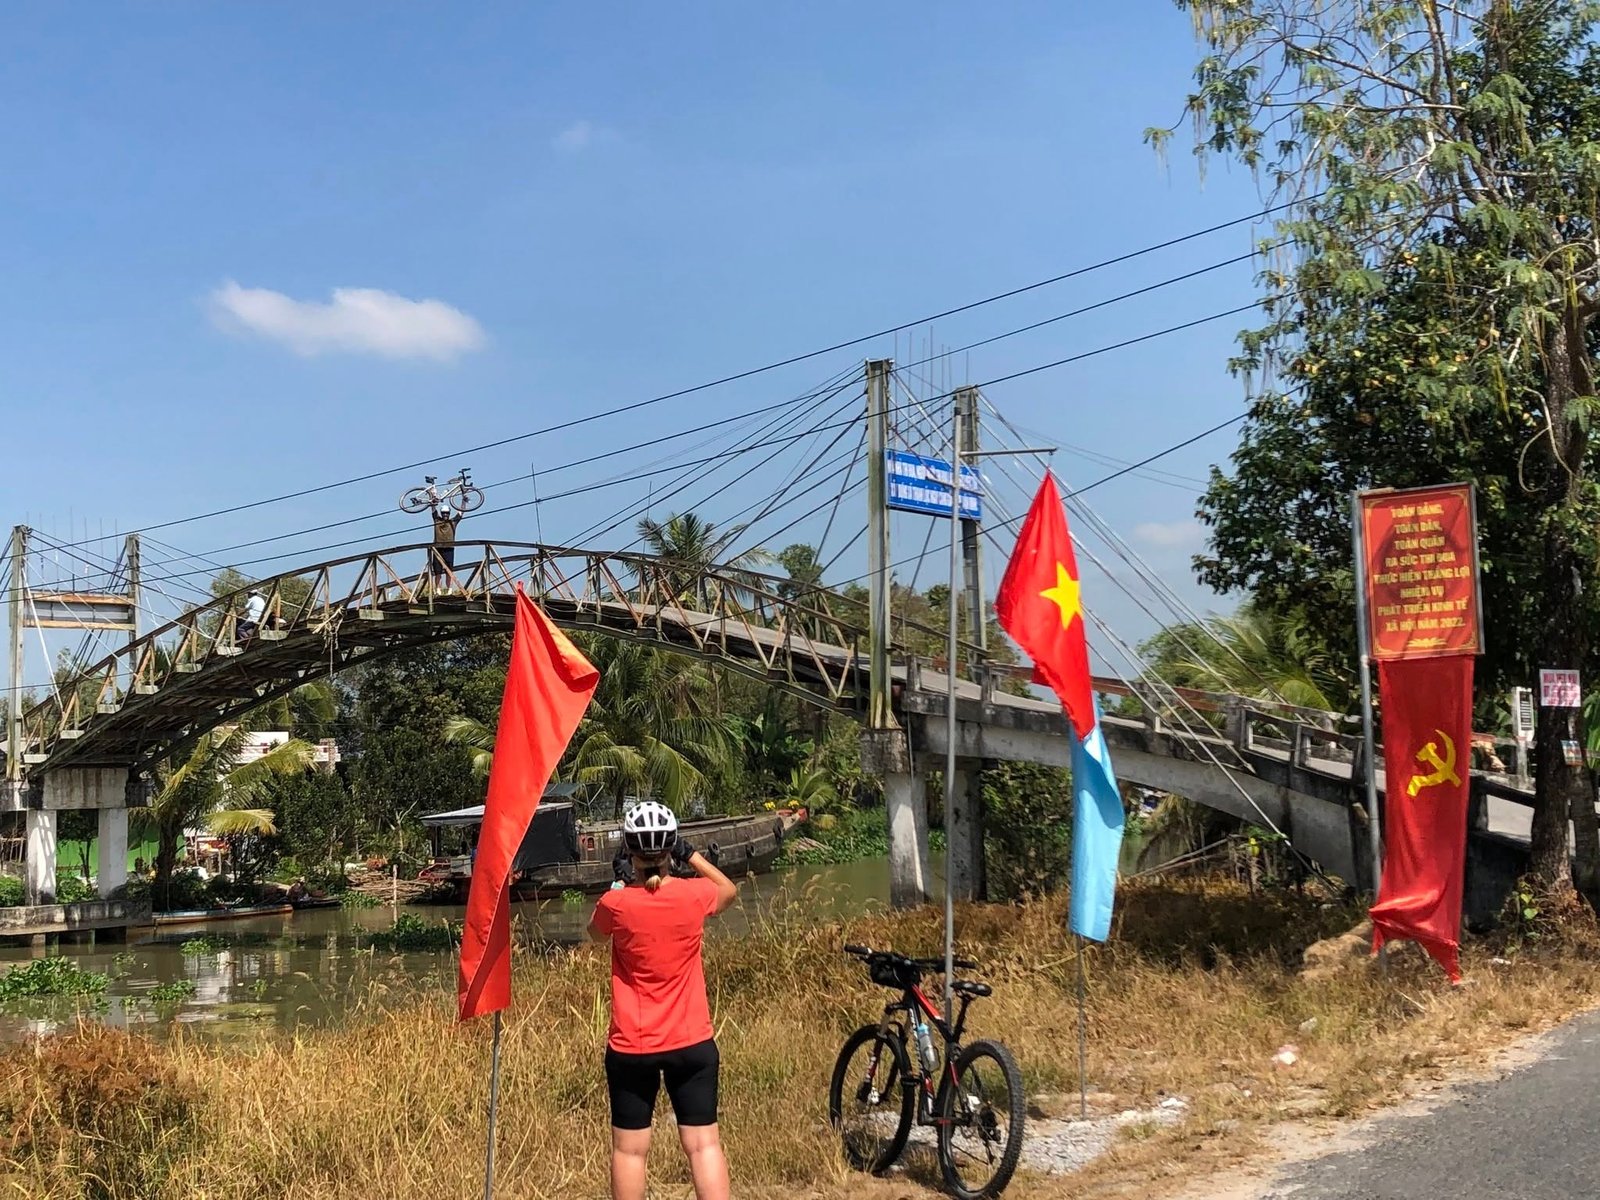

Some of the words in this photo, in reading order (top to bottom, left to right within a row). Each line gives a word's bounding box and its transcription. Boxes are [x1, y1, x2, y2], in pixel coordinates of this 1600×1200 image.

[1385, 557, 1398, 567] RA
[1431, 585, 1445, 597] VỤ
[1377, 603, 1401, 616] PHÁT
[1431, 601, 1454, 612] KINH
[1455, 596, 1470, 610] TẾ
[1386, 619, 1399, 632] XÃ
[1417, 617, 1439, 630] NĂM
